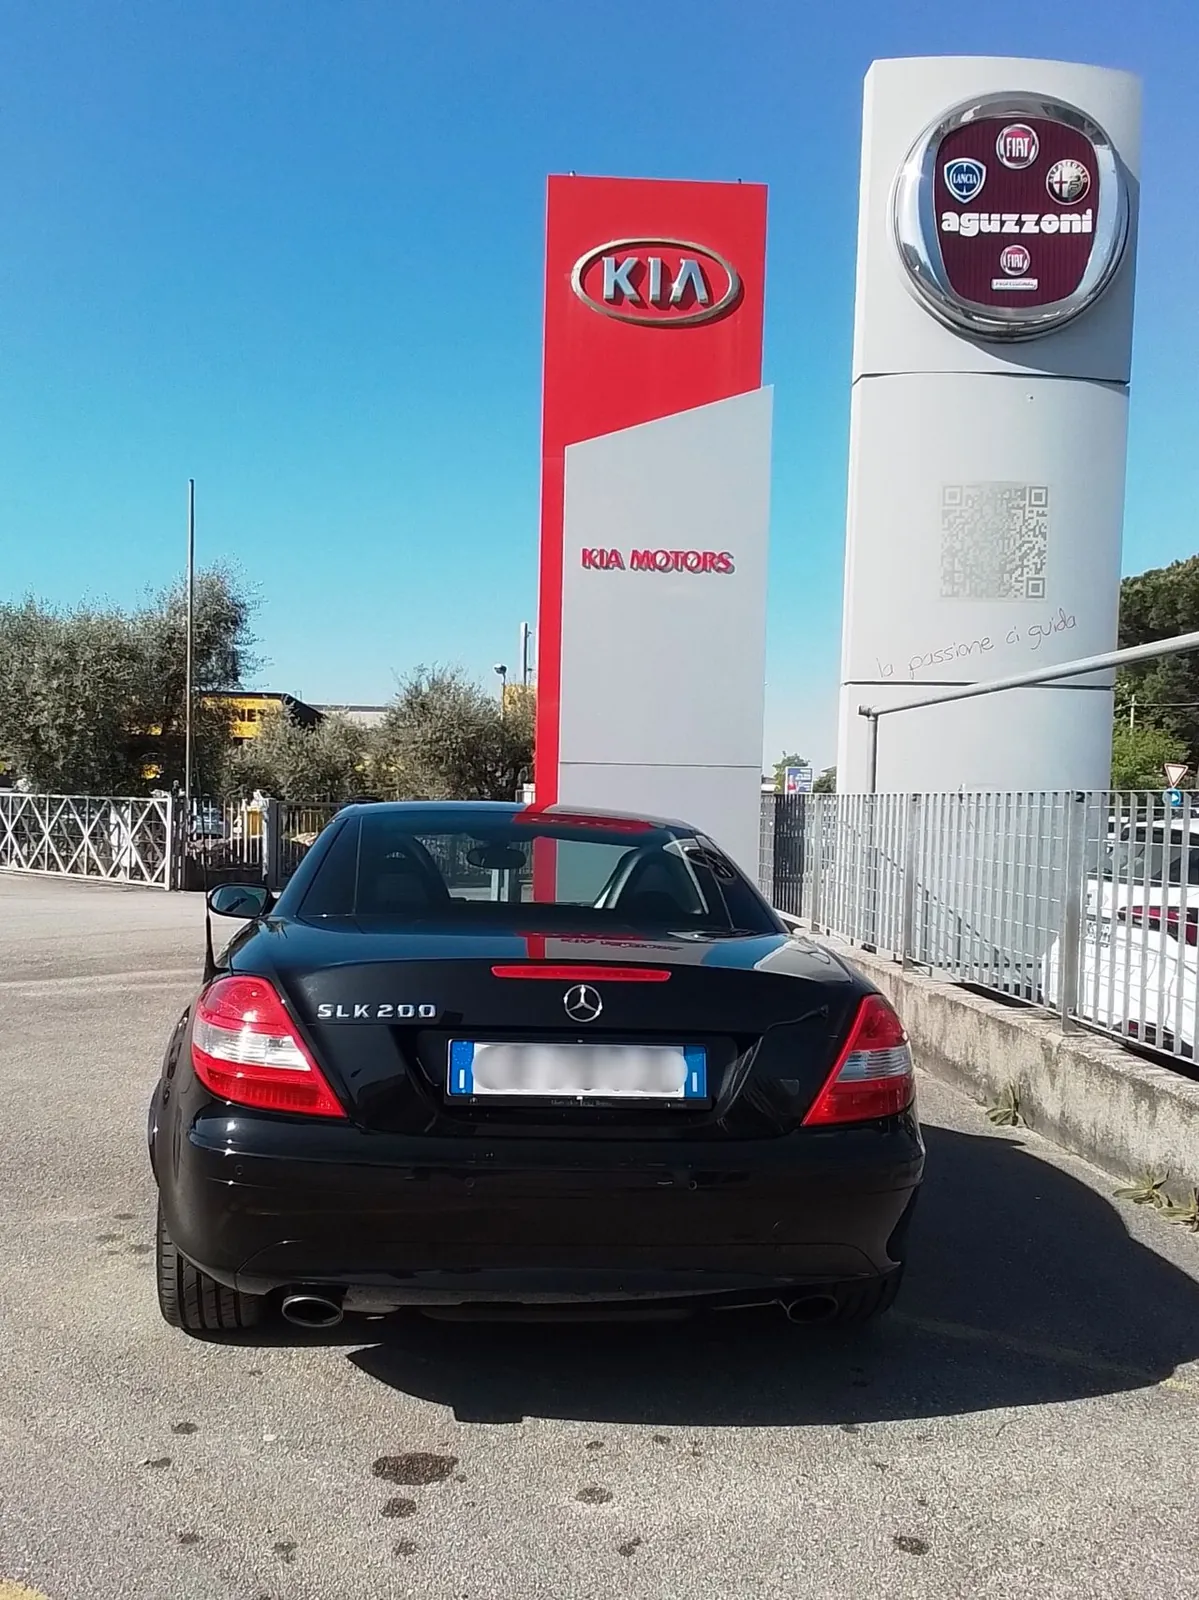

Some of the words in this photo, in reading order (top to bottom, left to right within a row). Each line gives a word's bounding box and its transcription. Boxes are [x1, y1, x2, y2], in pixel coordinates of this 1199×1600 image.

[1006, 137, 1030, 157] FIAT
[953, 173, 977, 184] LANCIA
[941, 208, 1093, 237] aguzzoni
[1007, 253, 1024, 268] FIAT
[602, 257, 708, 304] KIA
[581, 548, 625, 570] KIA
[630, 549, 735, 574] MOTORS
[876, 658, 894, 678] la
[908, 636, 994, 680] passione
[1006, 626, 1020, 644] ci
[1028, 607, 1077, 650] guida
[317, 1003, 370, 1019] SLK
[377, 1003, 436, 1018] 200
